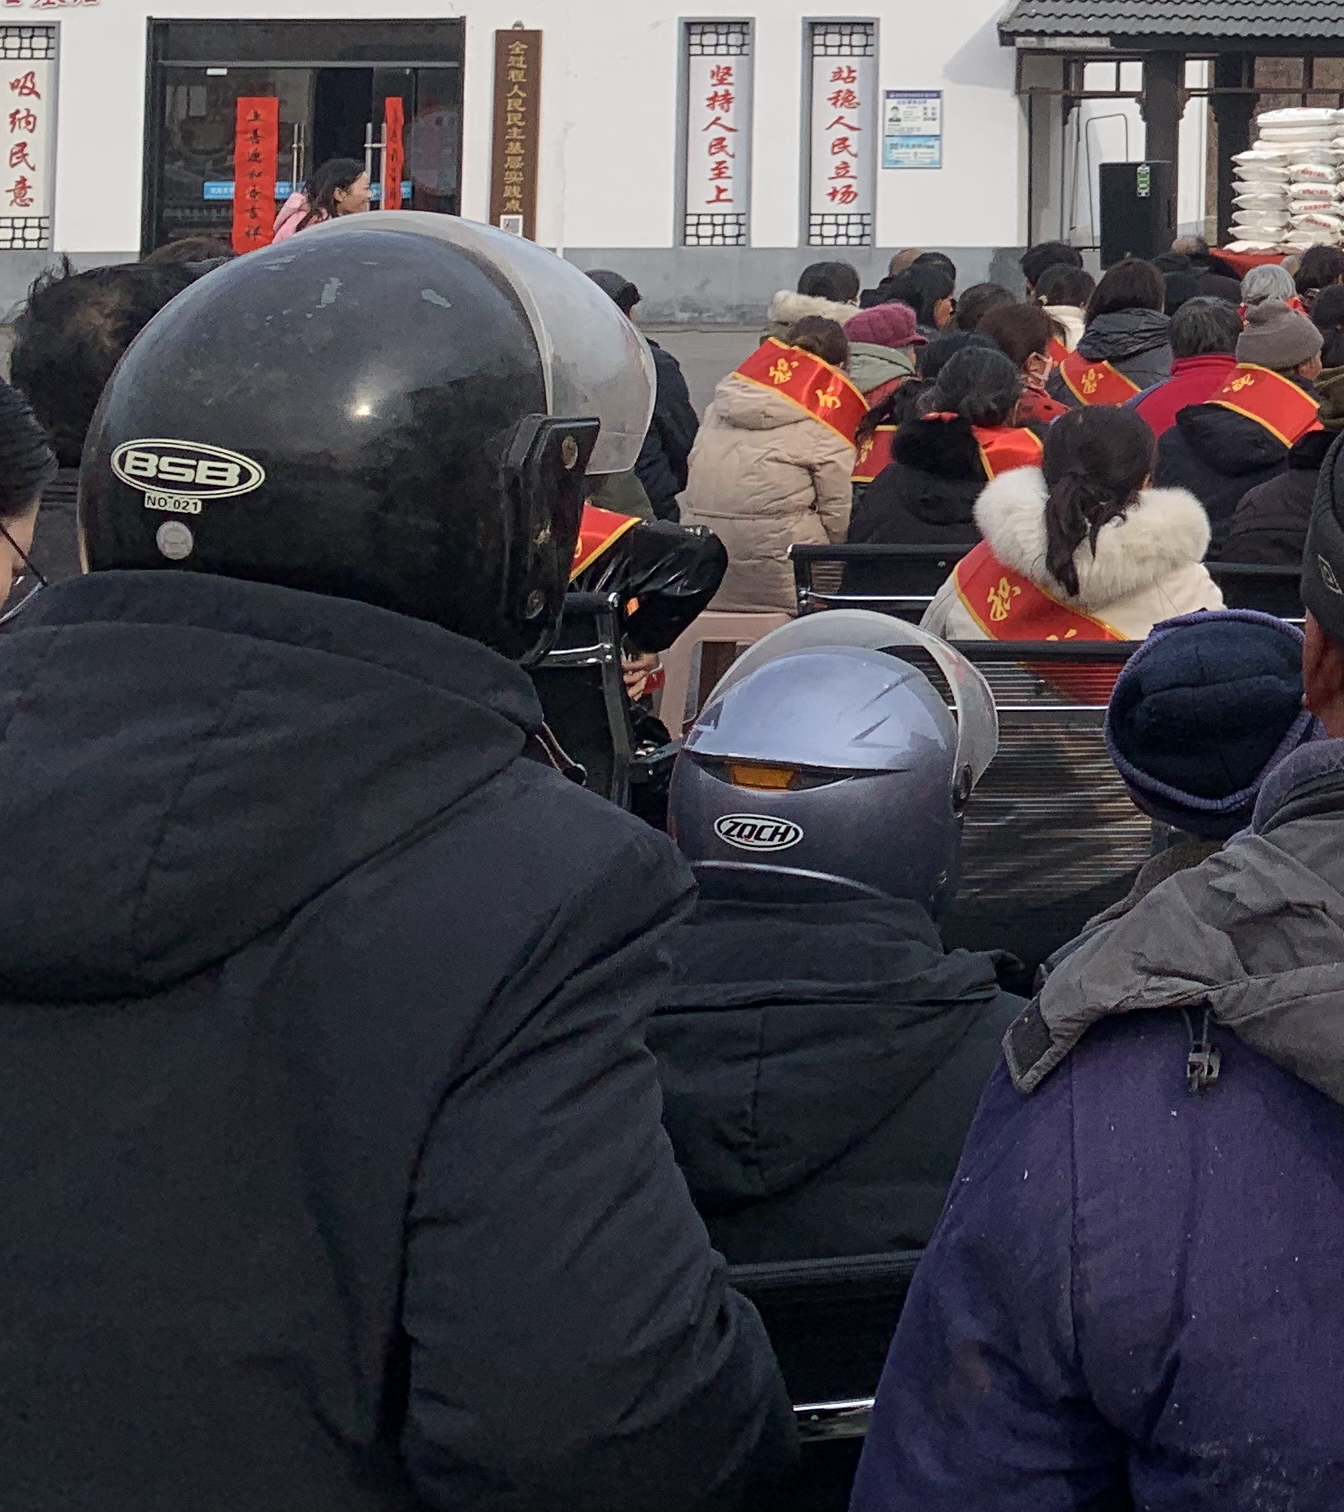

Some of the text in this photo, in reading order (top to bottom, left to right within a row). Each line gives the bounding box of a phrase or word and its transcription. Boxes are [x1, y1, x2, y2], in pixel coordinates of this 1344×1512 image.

[6, 70, 42, 208] 吸纳民意
[701, 64, 739, 205] 坚持人民至上
[824, 64, 863, 205] 站稳人民立场
[124, 450, 241, 487] BSB
[722, 820, 793, 843] ZOCH
